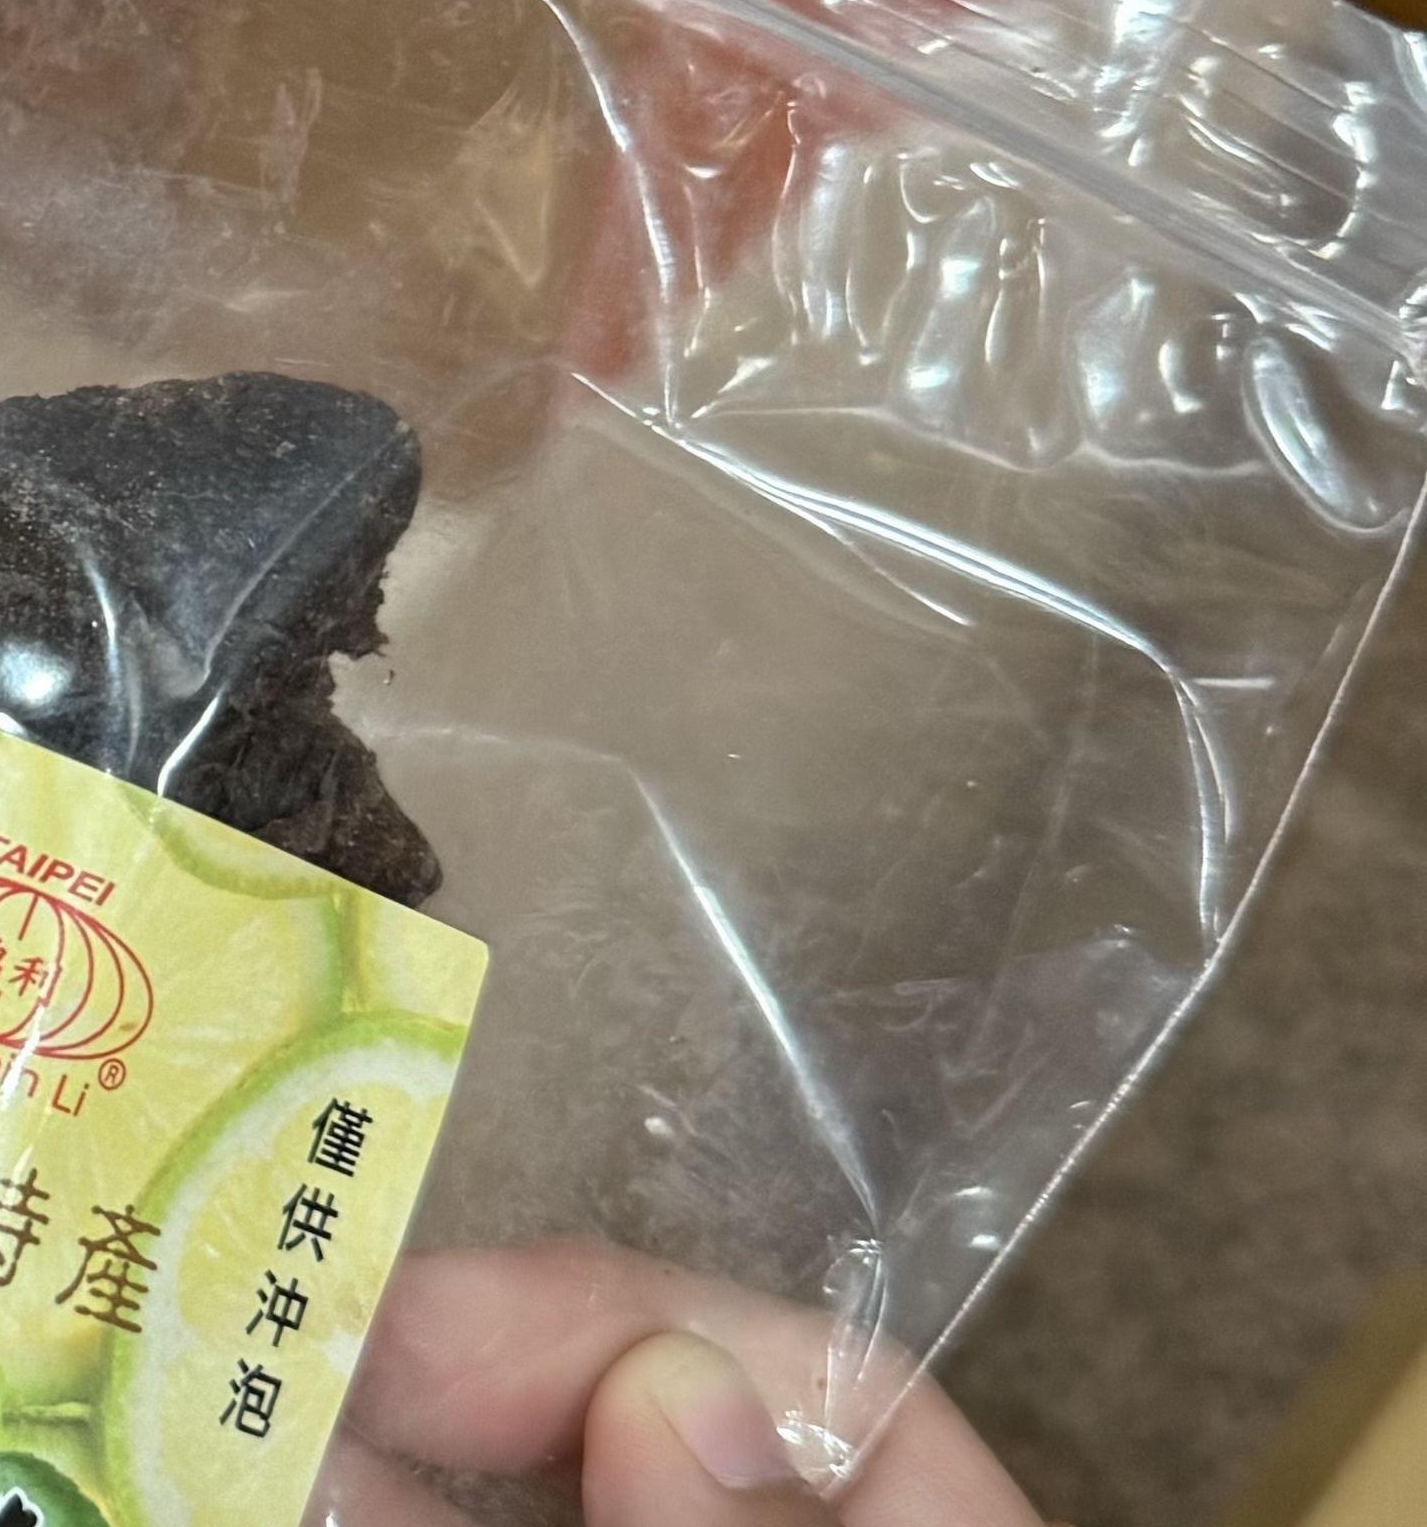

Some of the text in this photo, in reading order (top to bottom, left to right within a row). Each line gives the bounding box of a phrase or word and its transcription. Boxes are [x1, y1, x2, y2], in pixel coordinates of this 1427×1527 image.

[51, 1075, 89, 1119] Li
[221, 1099, 372, 1437] 僅供沖泡
